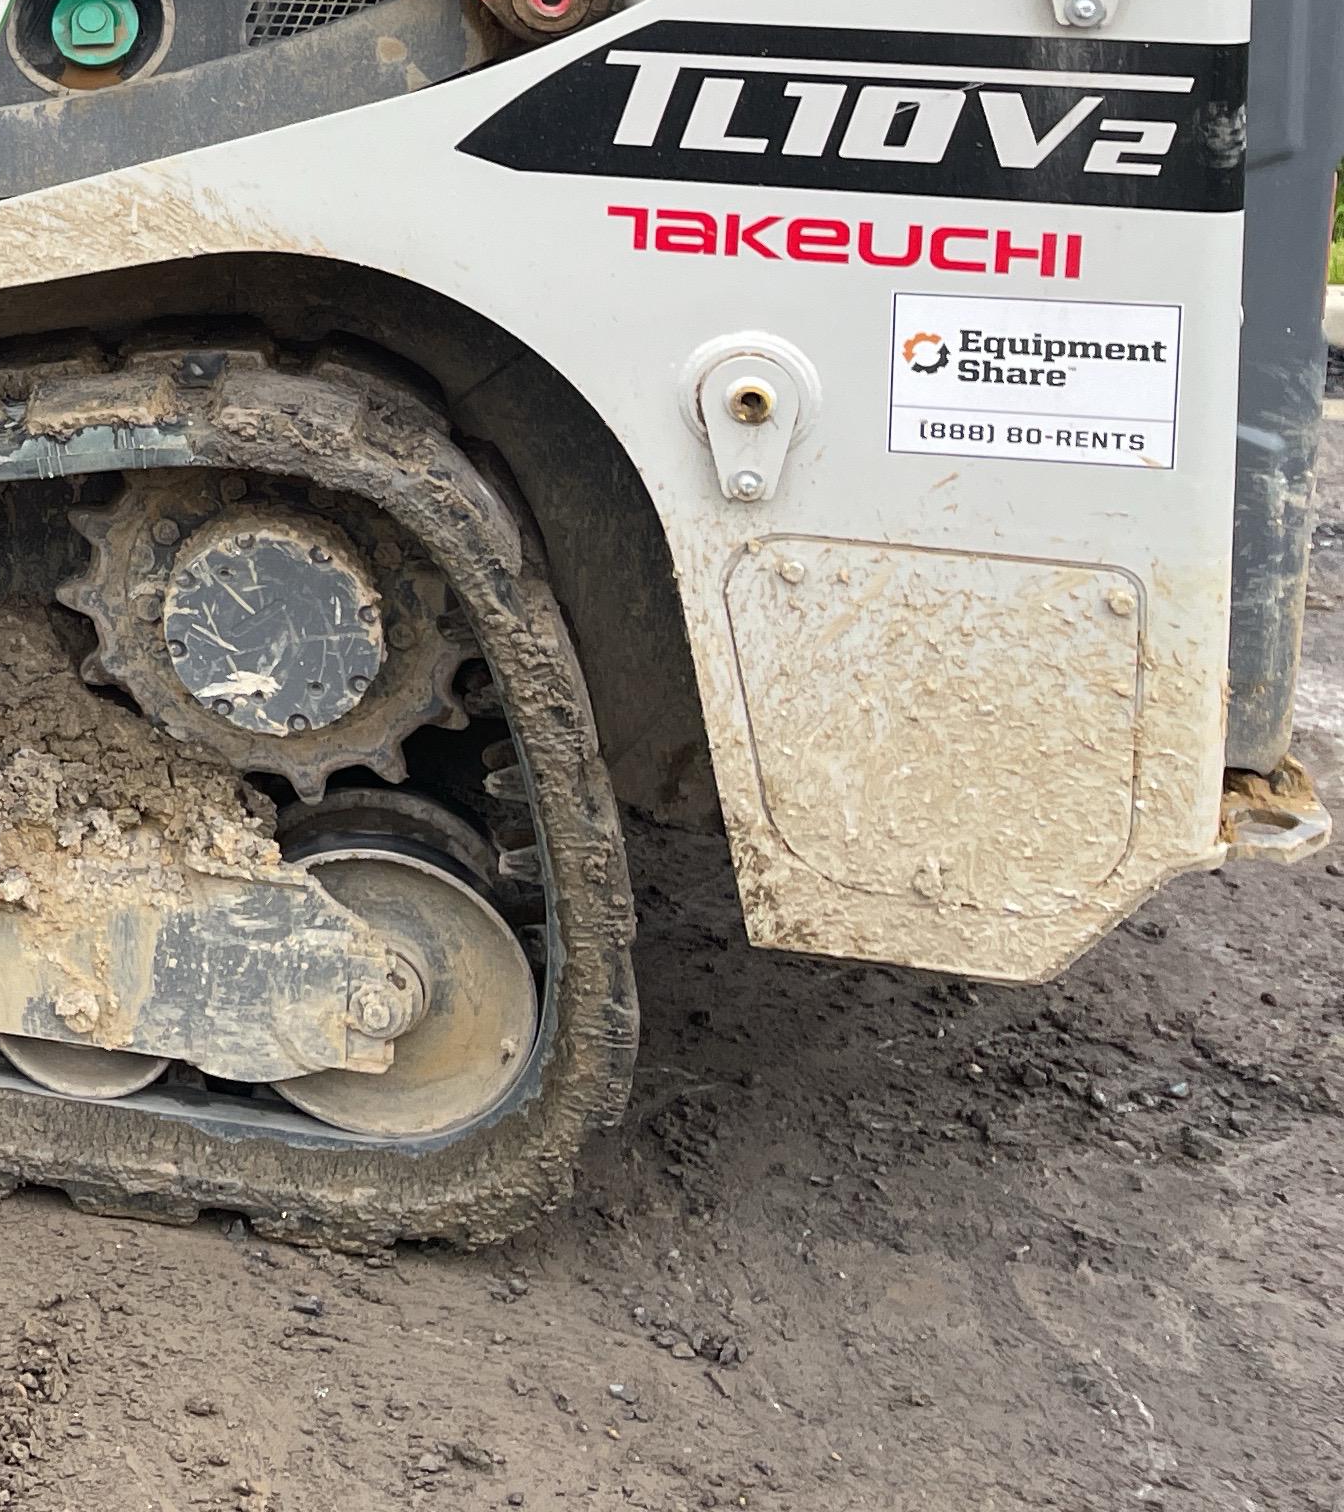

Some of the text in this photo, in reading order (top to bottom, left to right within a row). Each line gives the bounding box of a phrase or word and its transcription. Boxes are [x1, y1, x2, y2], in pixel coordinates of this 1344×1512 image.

[959, 329, 1168, 362] Equipment
[957, 357, 1068, 388] Share
[919, 422, 1146, 451] (888) 80-RENTS
